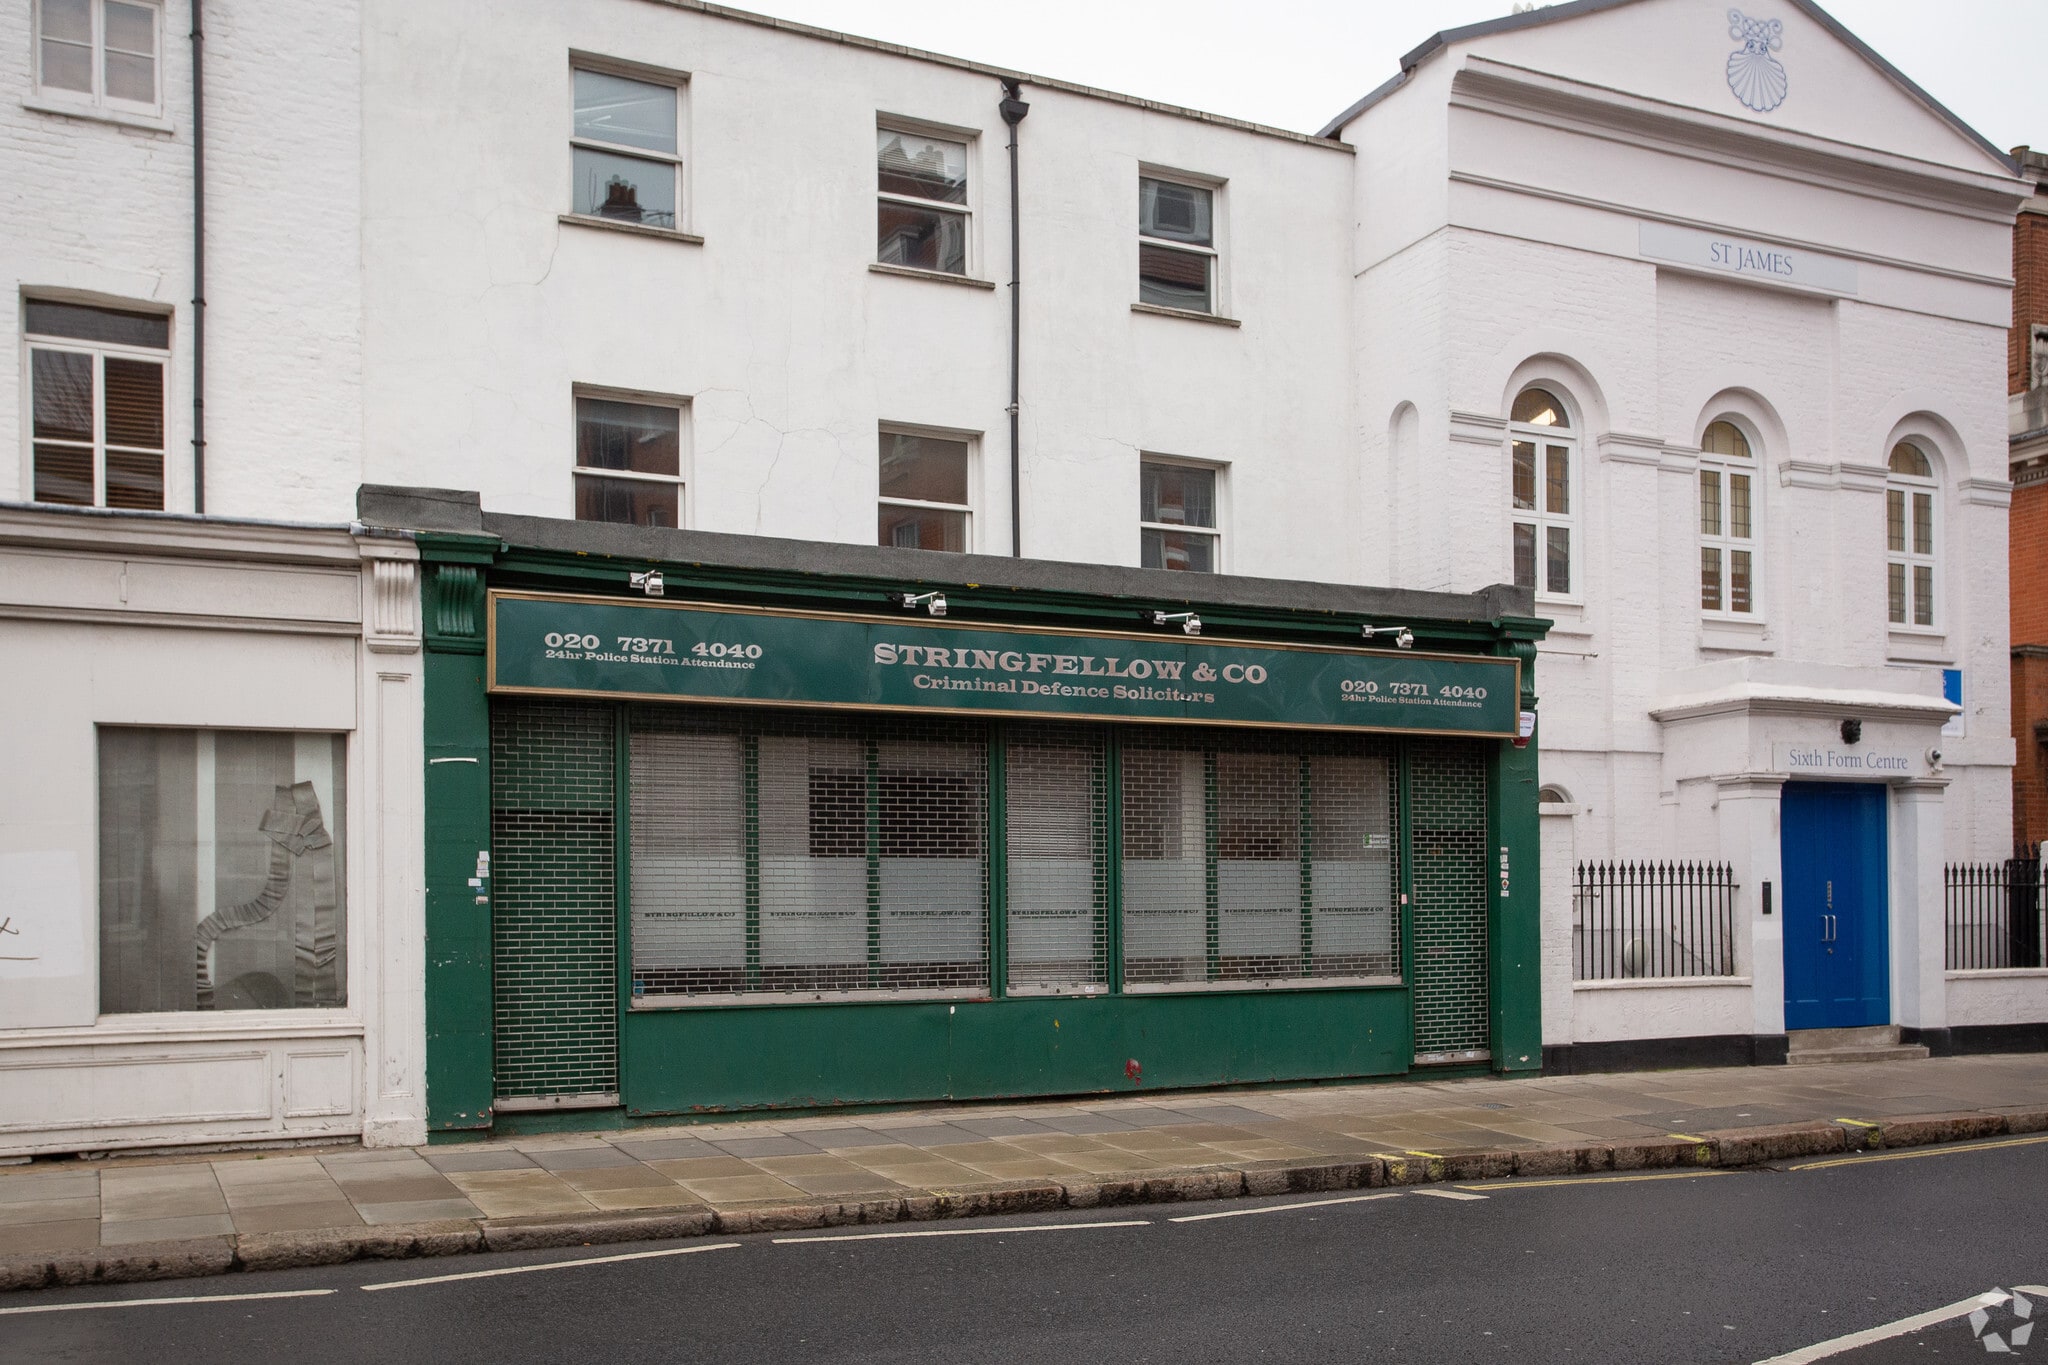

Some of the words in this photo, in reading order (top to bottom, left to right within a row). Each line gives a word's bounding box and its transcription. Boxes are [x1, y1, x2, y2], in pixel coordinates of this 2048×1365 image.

[1711, 241, 1732, 264] ST
[1735, 247, 1793, 276] JAMES
[544, 632, 600, 650] 020
[617, 636, 675, 655] 7371
[691, 642, 763, 659] 4040
[545, 649, 583, 661] 24hr
[585, 651, 629, 664] Police
[630, 653, 679, 666] Station
[681, 657, 756, 670] Attendance
[874, 642, 1186, 681] STRINGFELLOW
[1191, 662, 1218, 682] &
[1222, 663, 1268, 685] CO
[913, 674, 1018, 694] Criminal
[1021, 680, 1109, 698] Defence
[1340, 679, 1379, 694] 020
[1389, 682, 1429, 697] 7371
[1440, 685, 1488, 700] 4040
[1341, 693, 1367, 703] 24hr
[1368, 694, 1397, 705] Police
[1398, 696, 1432, 706] Station
[1433, 698, 1482, 708] Attendance
[1789, 749, 1823, 767] Sixth
[1827, 750, 1862, 768] Form
[1866, 752, 1909, 770] Centre
